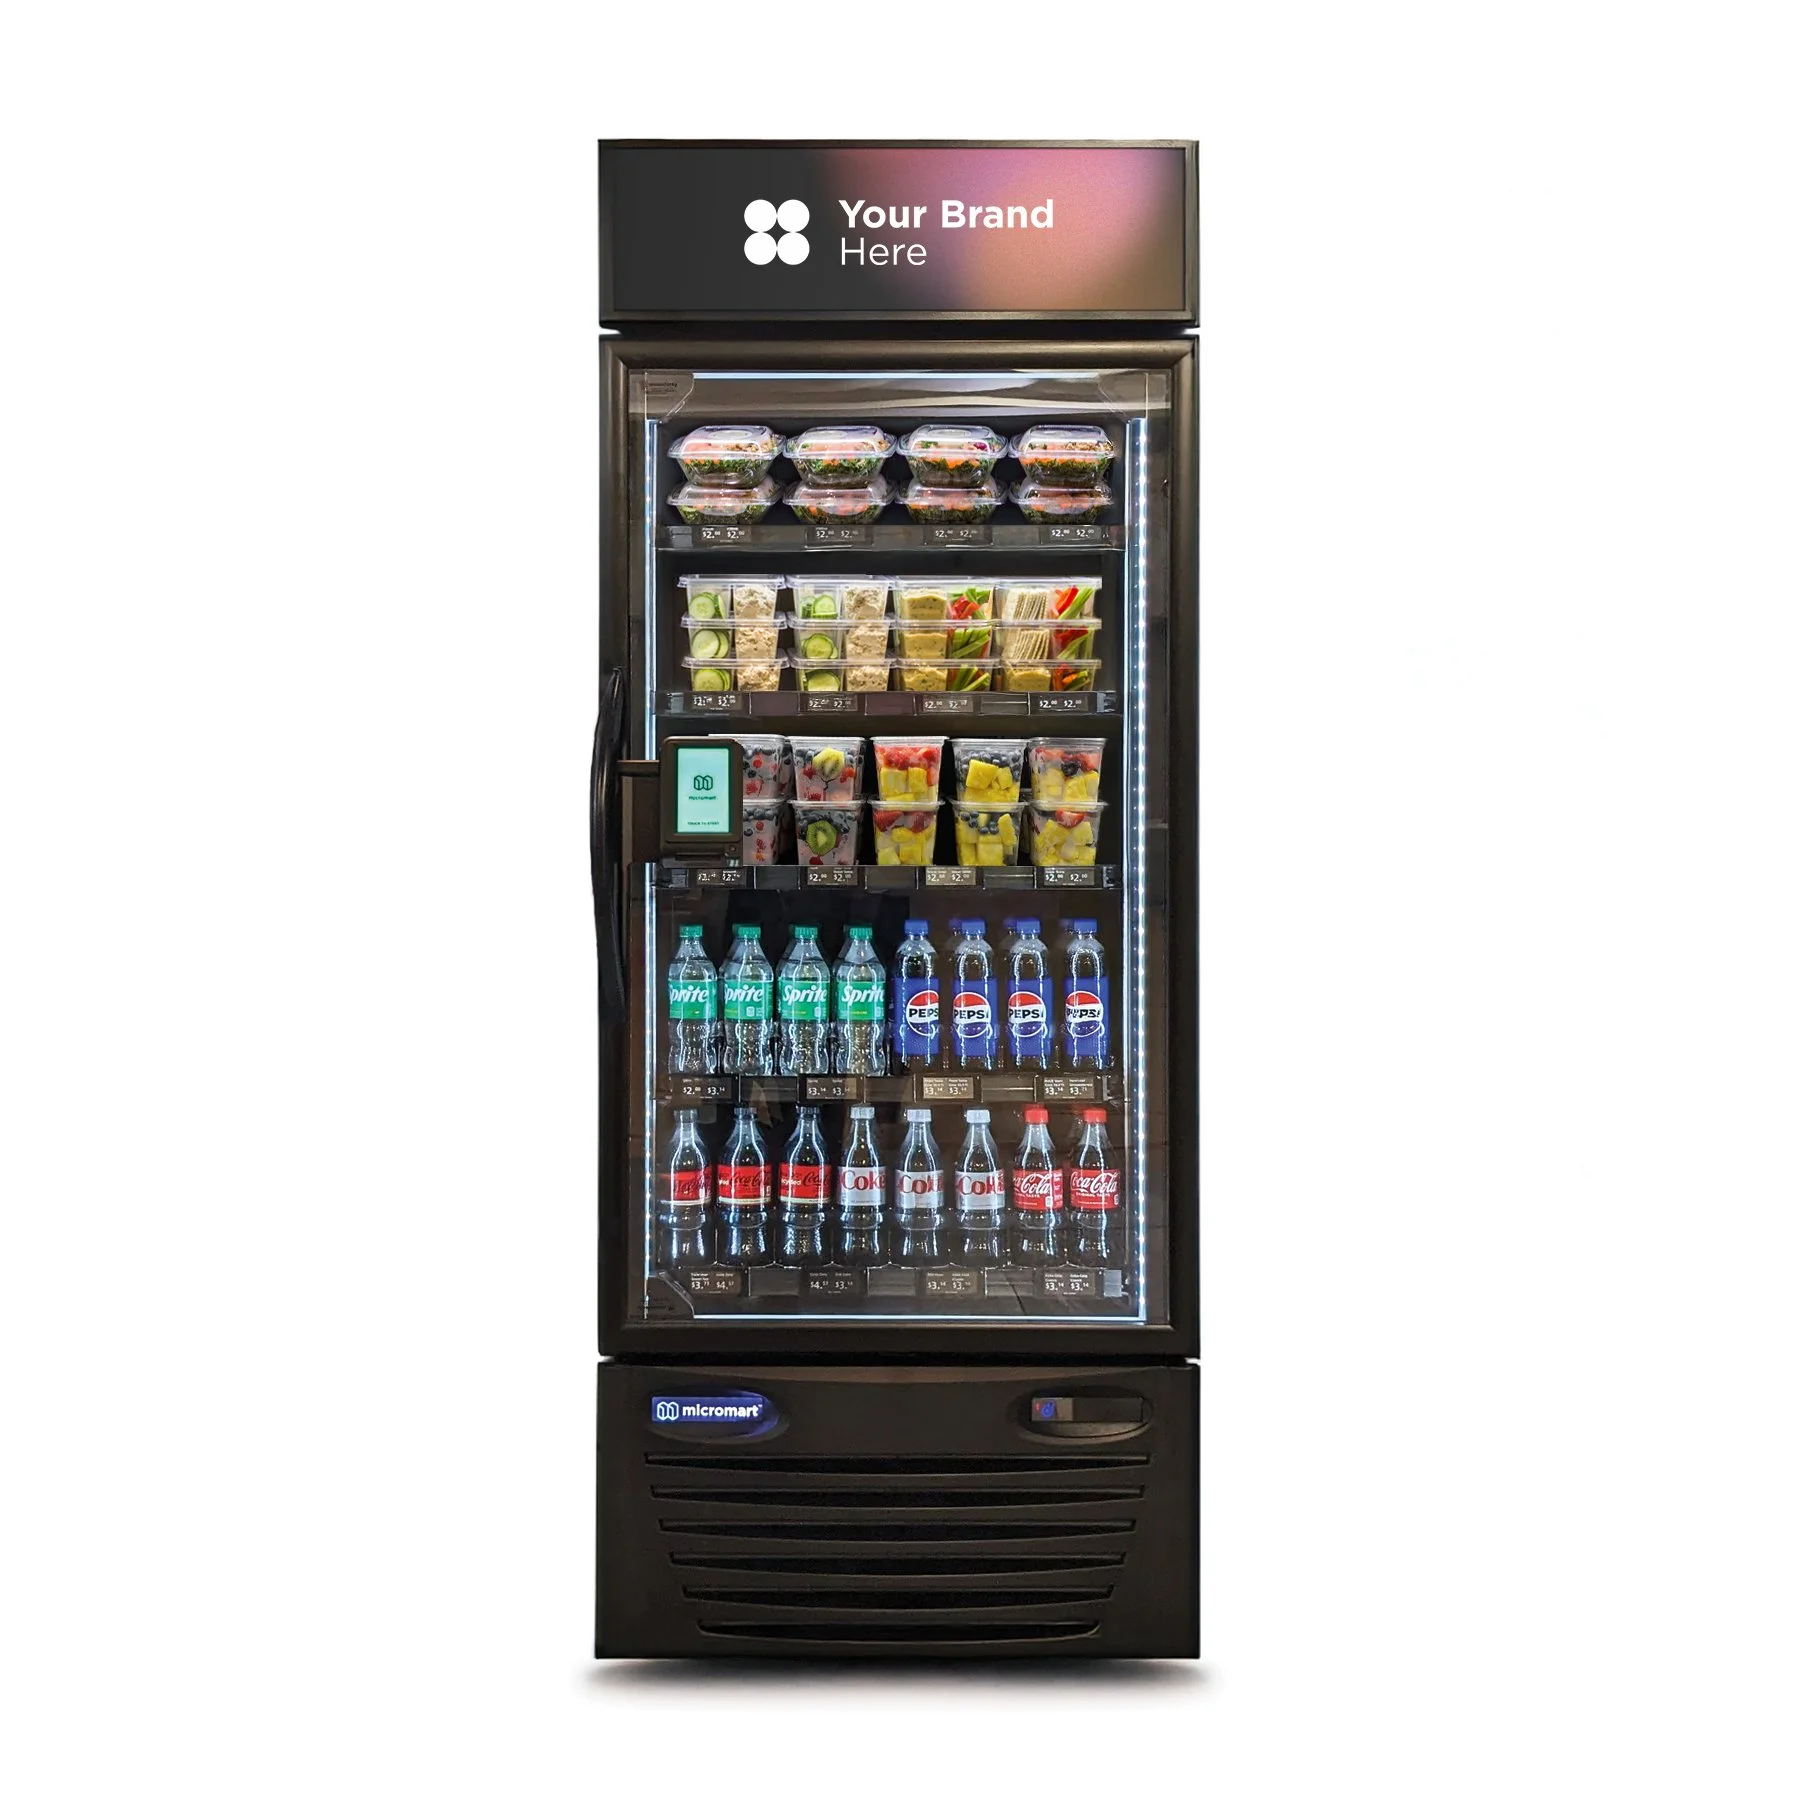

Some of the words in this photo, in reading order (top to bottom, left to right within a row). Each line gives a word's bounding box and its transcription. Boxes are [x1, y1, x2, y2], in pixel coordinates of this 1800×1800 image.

[839, 200, 926, 229] Your
[941, 199, 1054, 229] Brand
[841, 237, 927, 265] Here
[782, 984, 828, 1006] Sprite
[909, 1008, 939, 1018] PEPS
[841, 1170, 886, 1190] Coke
[1013, 1173, 1052, 1194] ca-Cola
[1070, 1171, 1119, 1194] Coca-Cola
[682, 1404, 759, 1418] micromart
